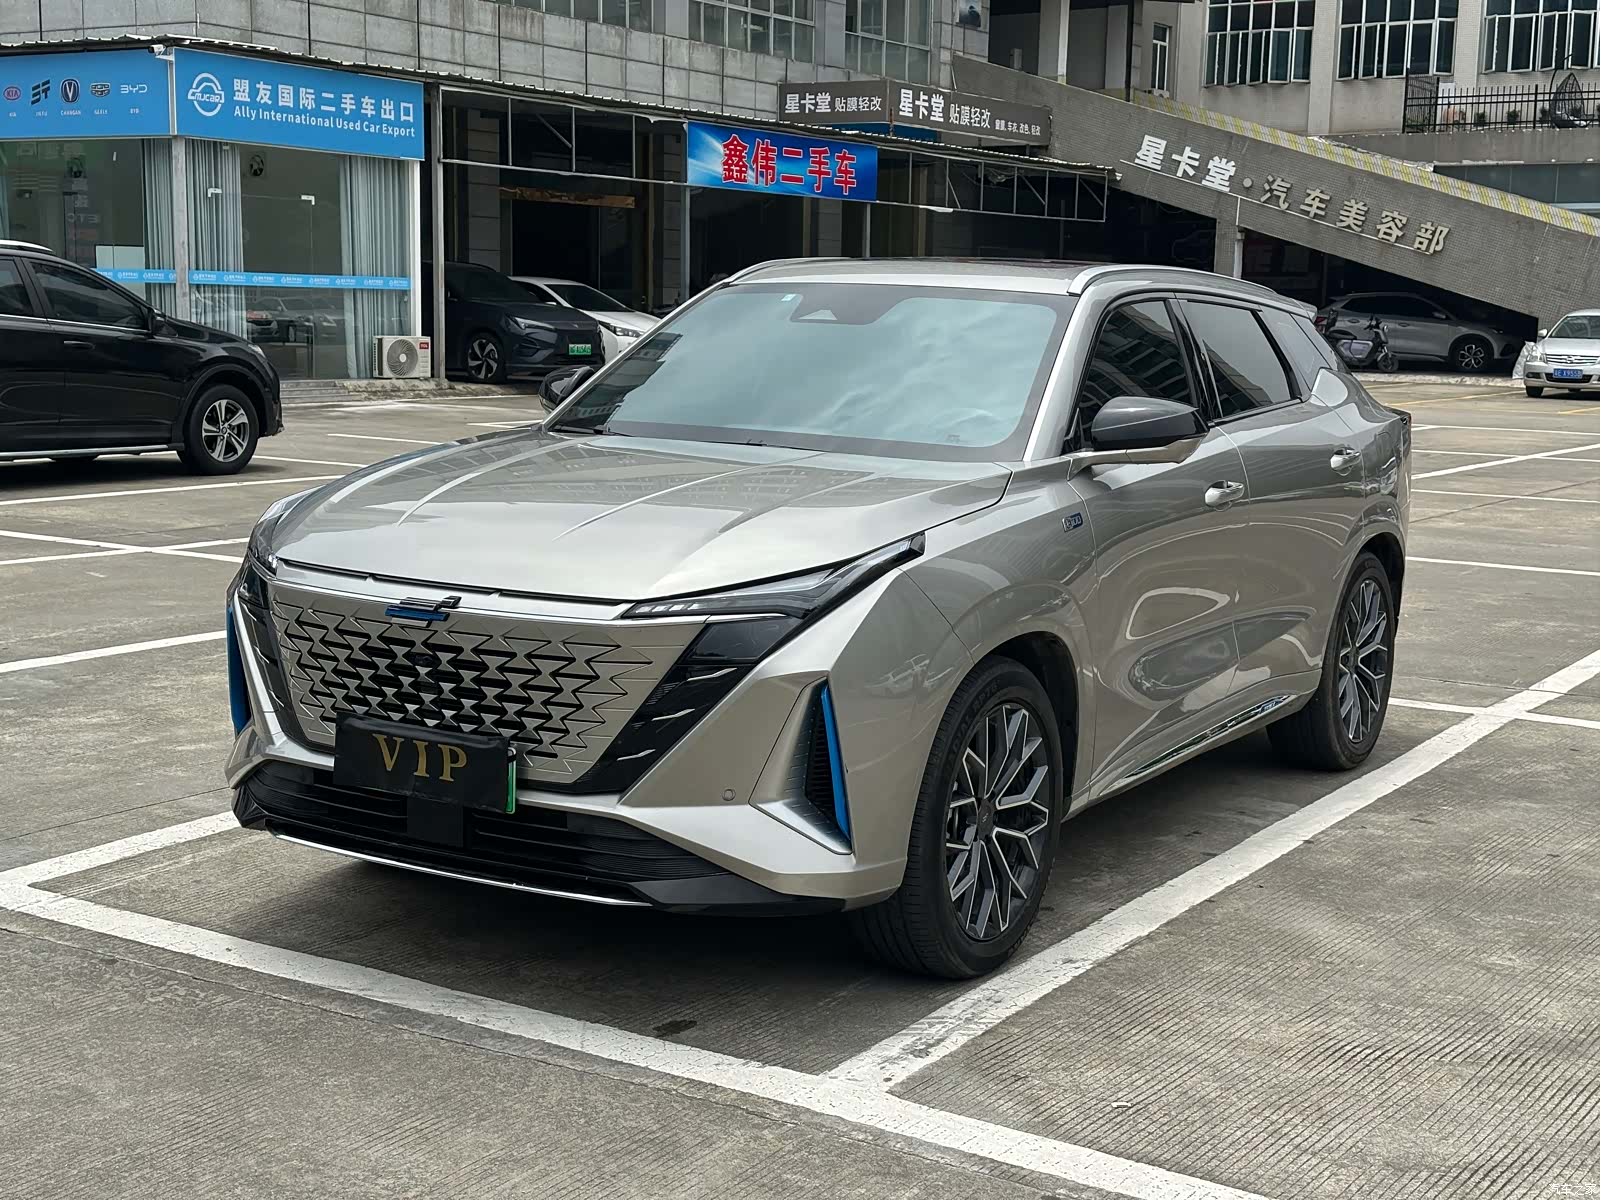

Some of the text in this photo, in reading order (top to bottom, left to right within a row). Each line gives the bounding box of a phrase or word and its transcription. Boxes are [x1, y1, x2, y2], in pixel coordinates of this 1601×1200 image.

[120, 84, 148, 94] BYD
[233, 78, 414, 123] 盟友国际二手车出口
[785, 92, 882, 113] 星卡堂 贴膜轻改
[899, 88, 945, 122] 星卡堂
[949, 103, 991, 129] 贴膜轻改
[234, 105, 415, 138] Ally International Used Car Export
[721, 133, 858, 195] 鑫伟二手车
[372, 733, 468, 782] VIP
